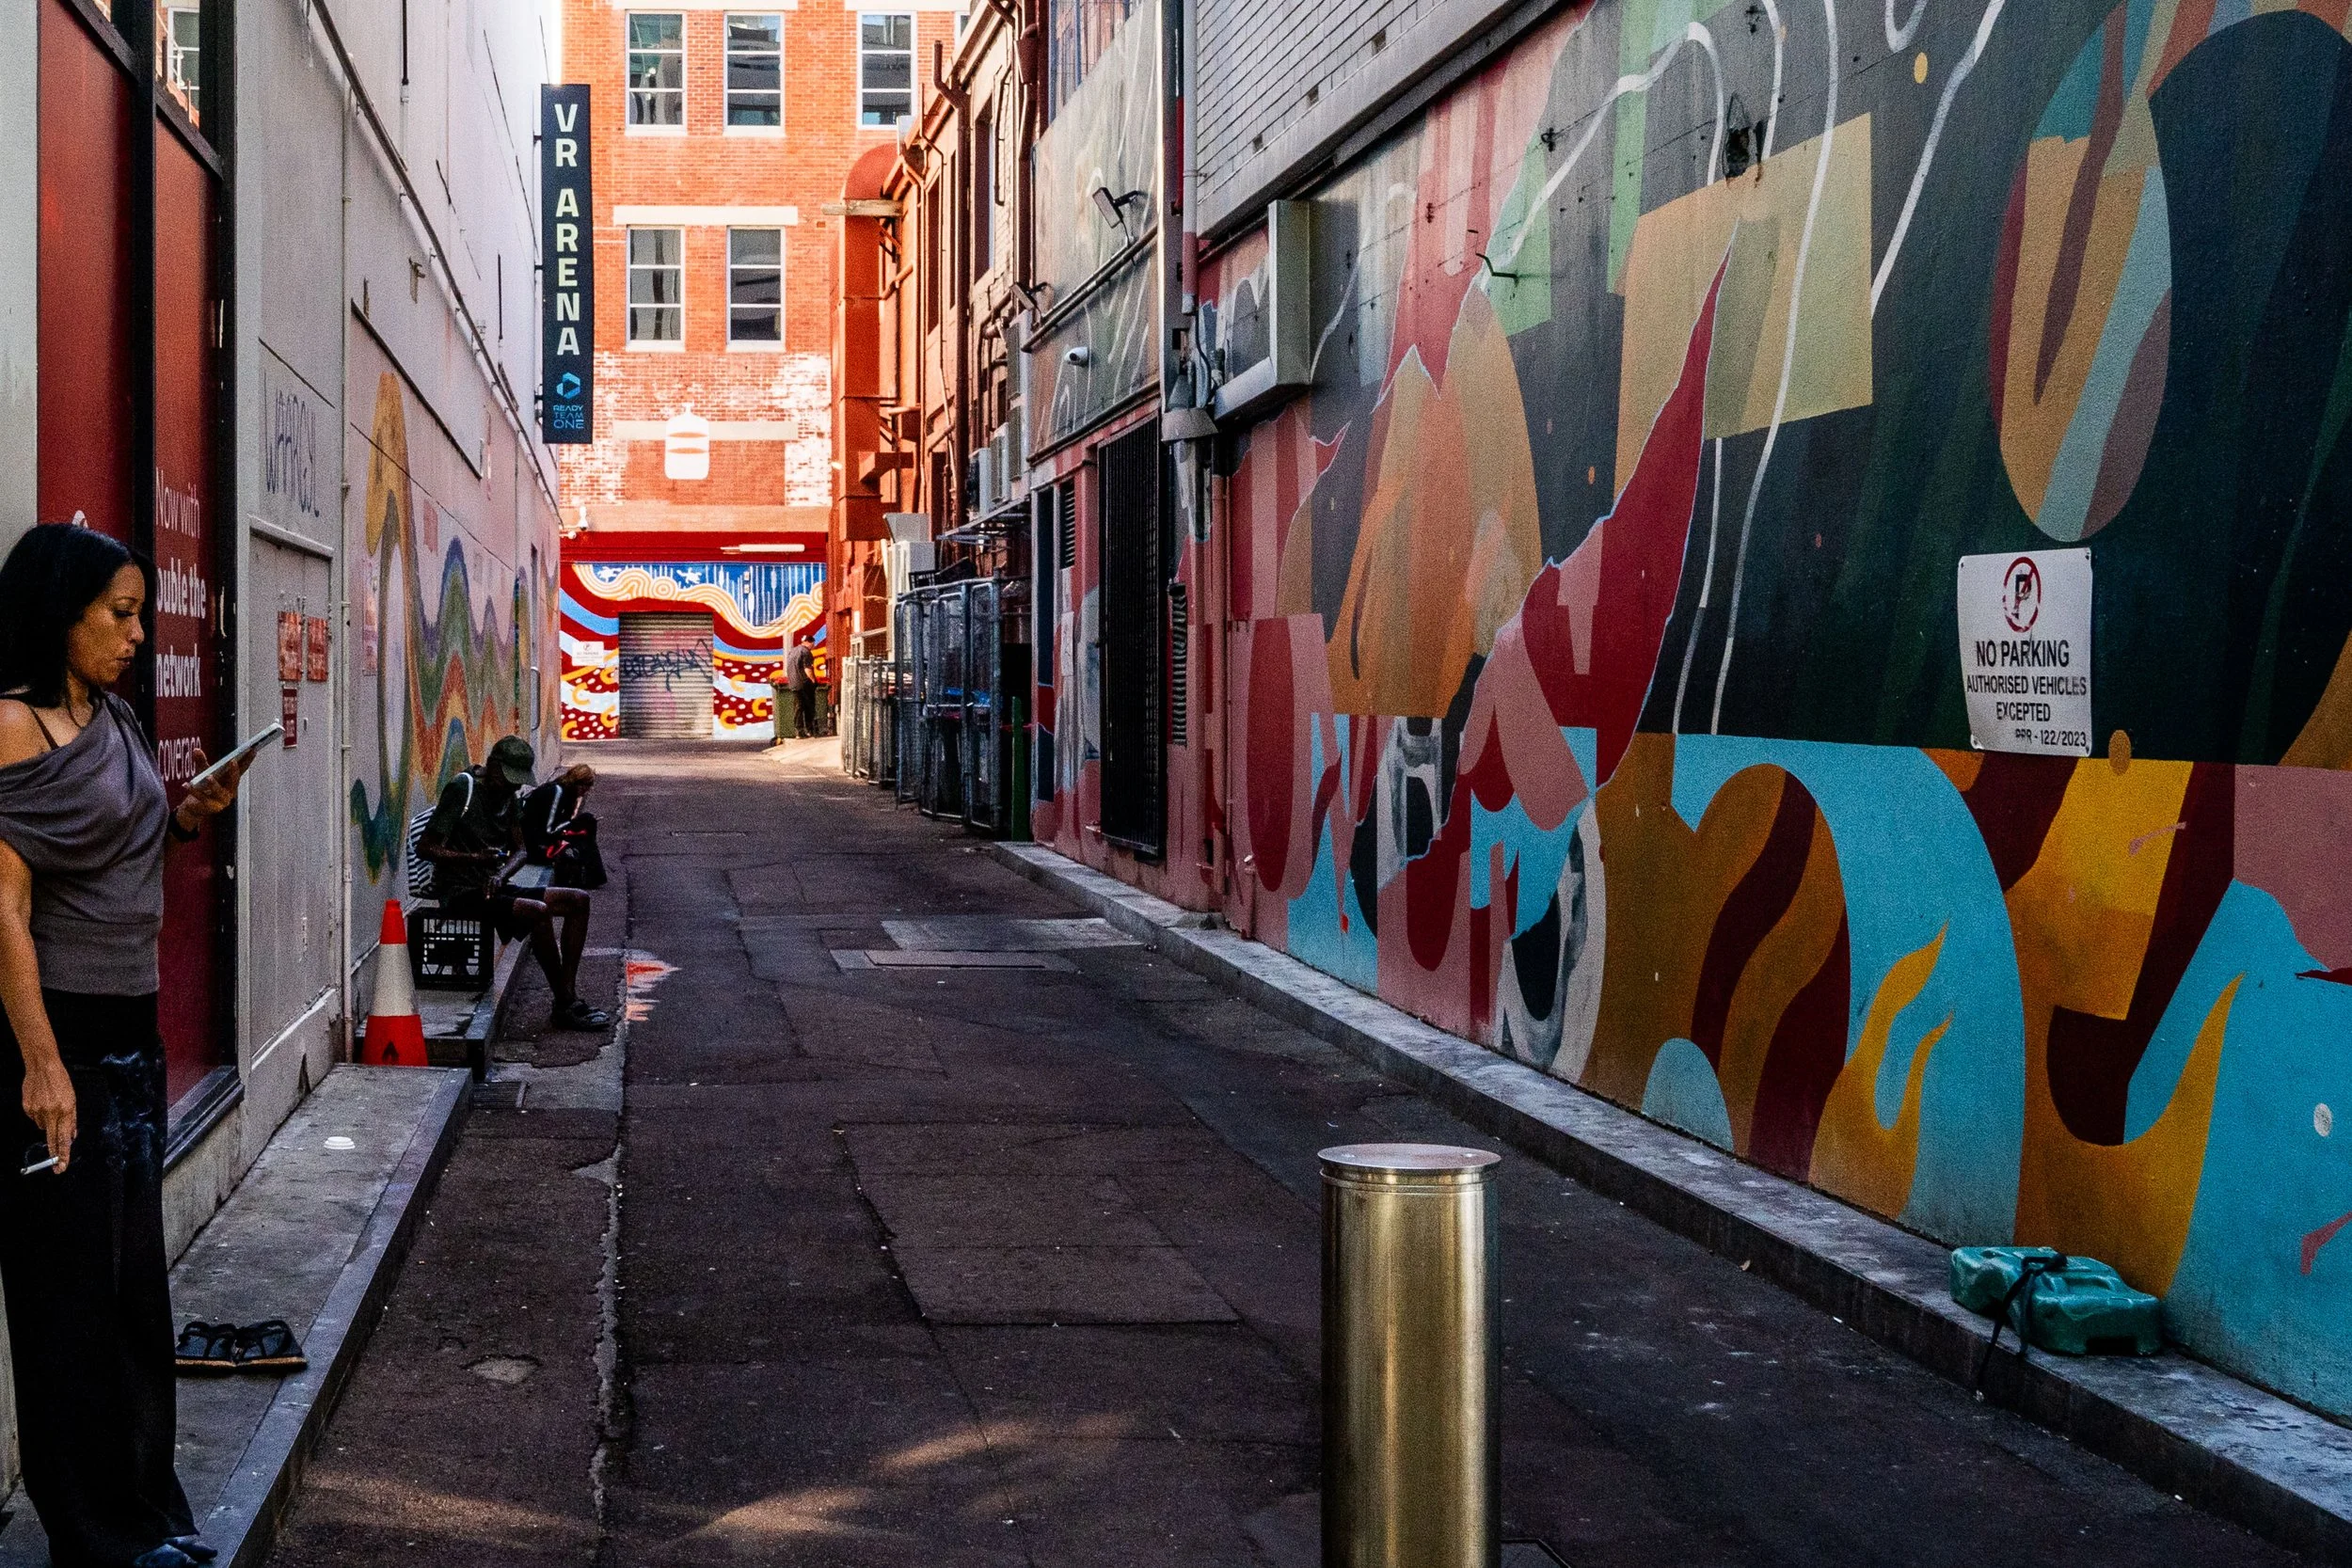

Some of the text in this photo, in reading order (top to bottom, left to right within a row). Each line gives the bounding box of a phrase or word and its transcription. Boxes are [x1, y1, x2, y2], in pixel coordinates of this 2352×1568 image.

[554, 103, 580, 356] VR ARENA
[553, 419, 584, 429] ONE
[156, 467, 200, 540] Now with
[156, 557, 207, 620] ouble the
[1977, 639, 2071, 667] NO PARKING
[156, 642, 201, 697] network
[1967, 674, 2087, 696] AUTHORISED VEHICLES
[1996, 702, 2051, 721] EXCEPTED
[2040, 729, 2087, 747] 122/2023
